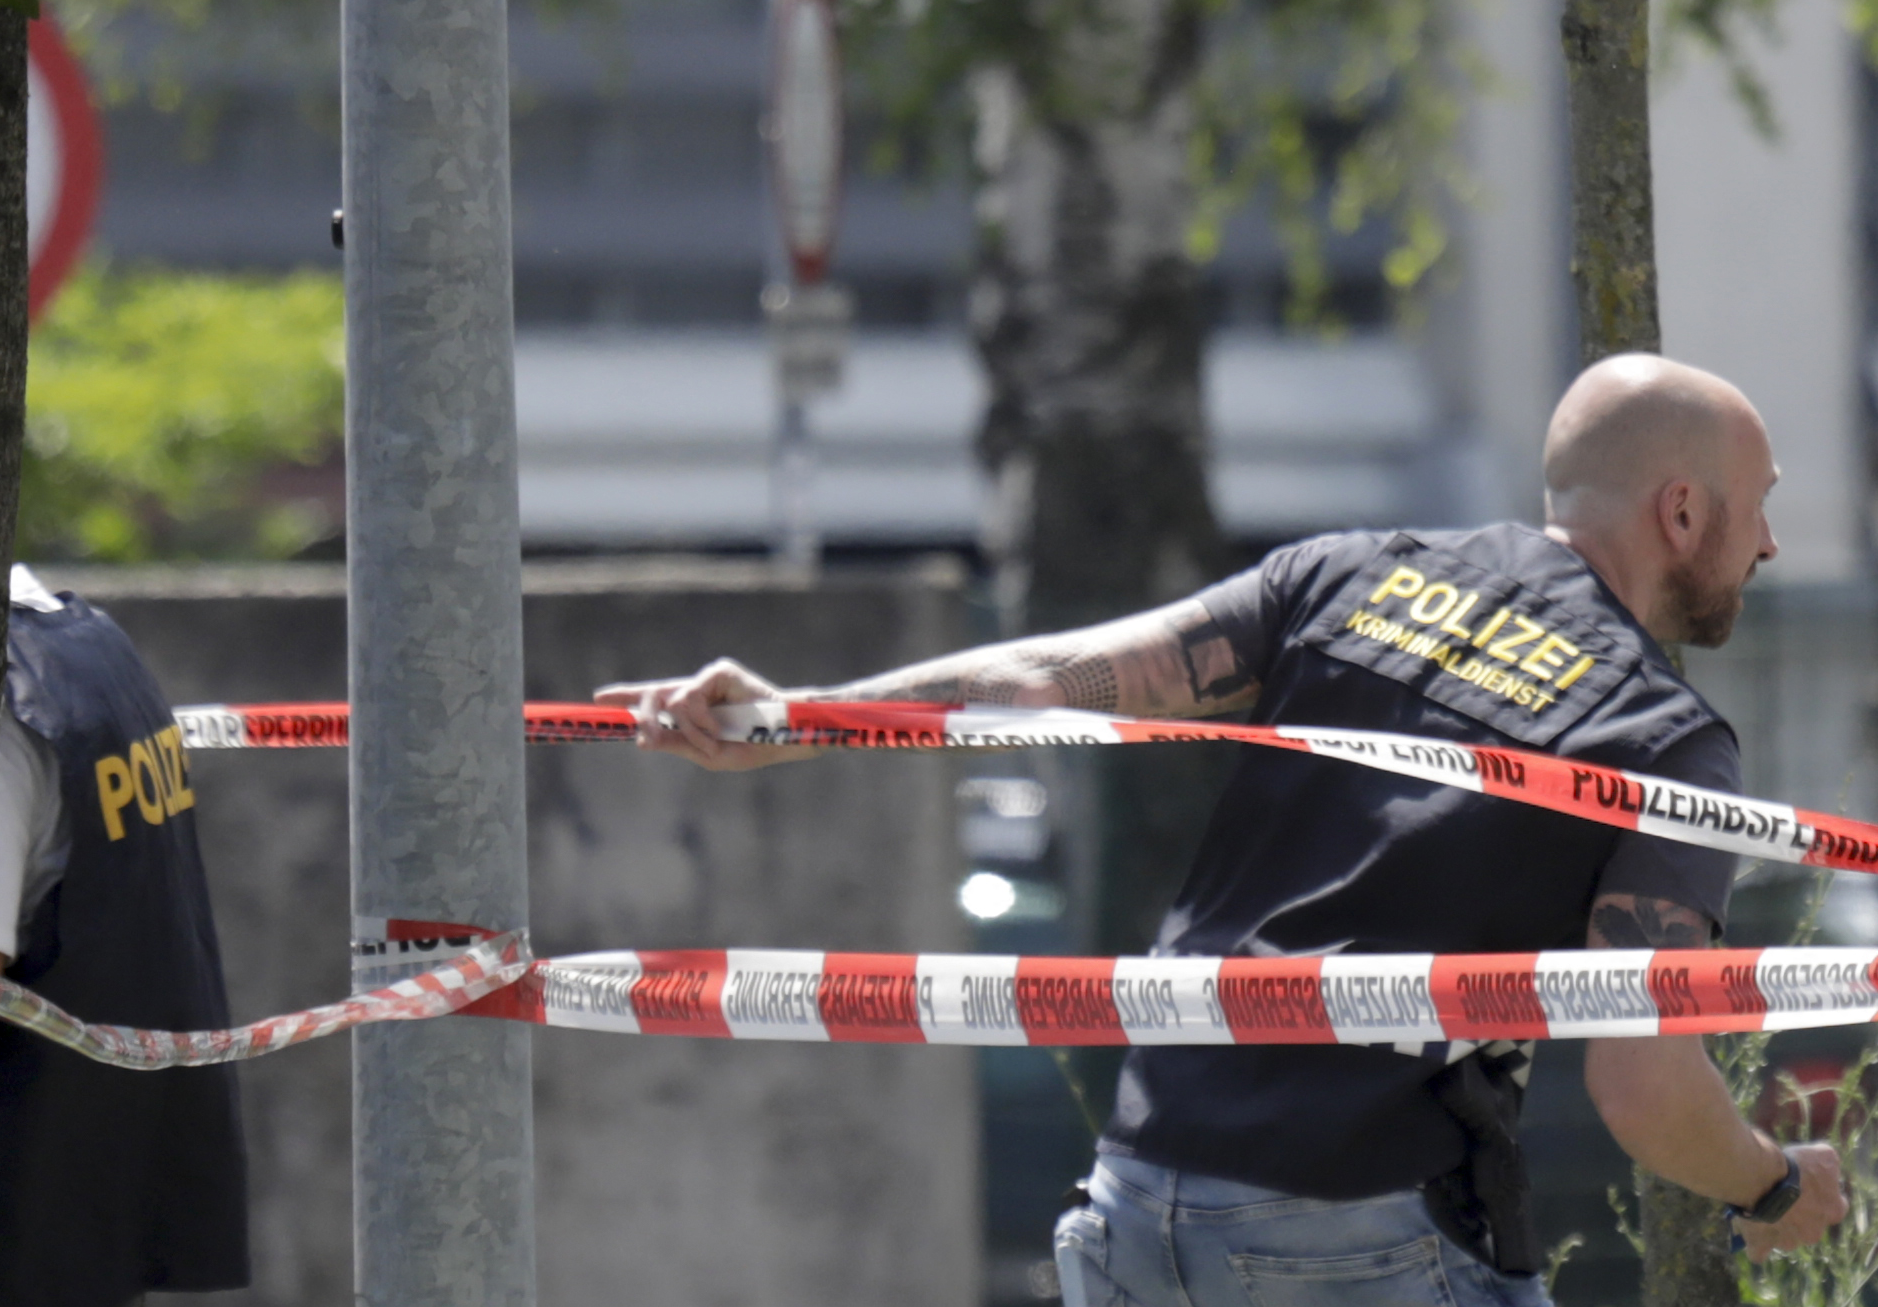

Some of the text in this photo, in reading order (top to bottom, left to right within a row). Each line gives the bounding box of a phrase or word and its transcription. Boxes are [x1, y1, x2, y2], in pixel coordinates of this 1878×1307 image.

[1346, 609, 1555, 712] KRIMINALDIENST
[1369, 565, 1596, 690] POLIZEI
[95, 724, 195, 842] POLIZ
